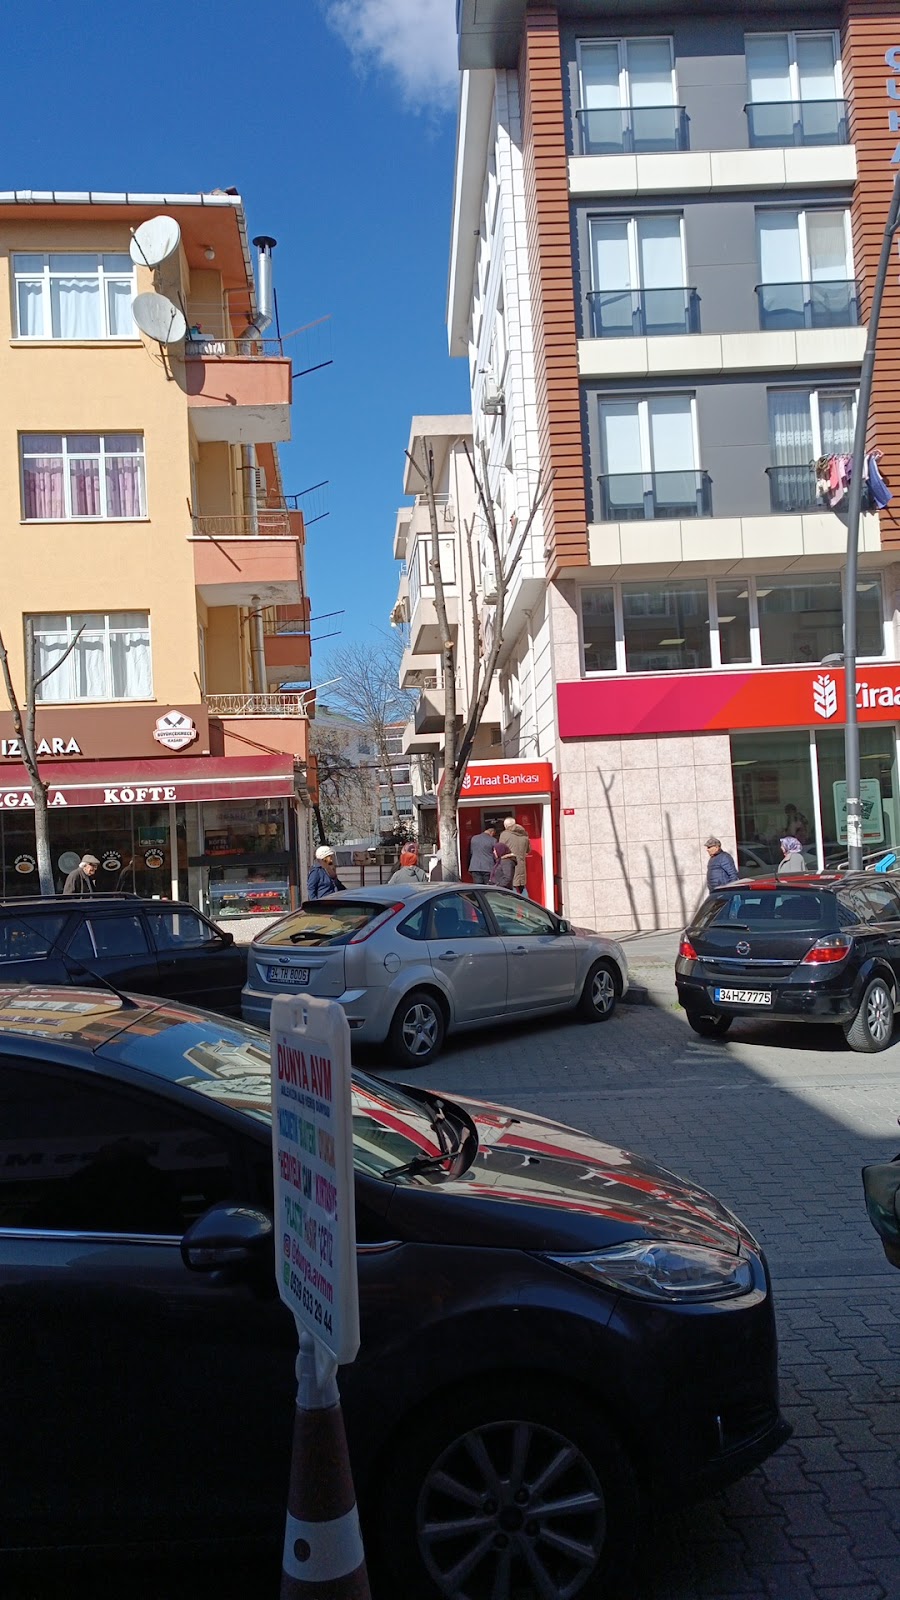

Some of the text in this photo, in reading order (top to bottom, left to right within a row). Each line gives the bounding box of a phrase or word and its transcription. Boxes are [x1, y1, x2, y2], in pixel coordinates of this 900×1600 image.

[2, 736, 81, 756] IZARA
[473, 773, 539, 786] Ziraat Bankası
[0, 786, 177, 807] GAA KÖFTE
[271, 967, 278, 978] 34
[281, 968, 289, 978] TH
[277, 1037, 309, 1091] DÜNYA
[310, 1053, 332, 1102] AVM
[302, 1286, 314, 1315] 633
[314, 1299, 323, 1325] 29
[323, 1309, 333, 1336] 44
